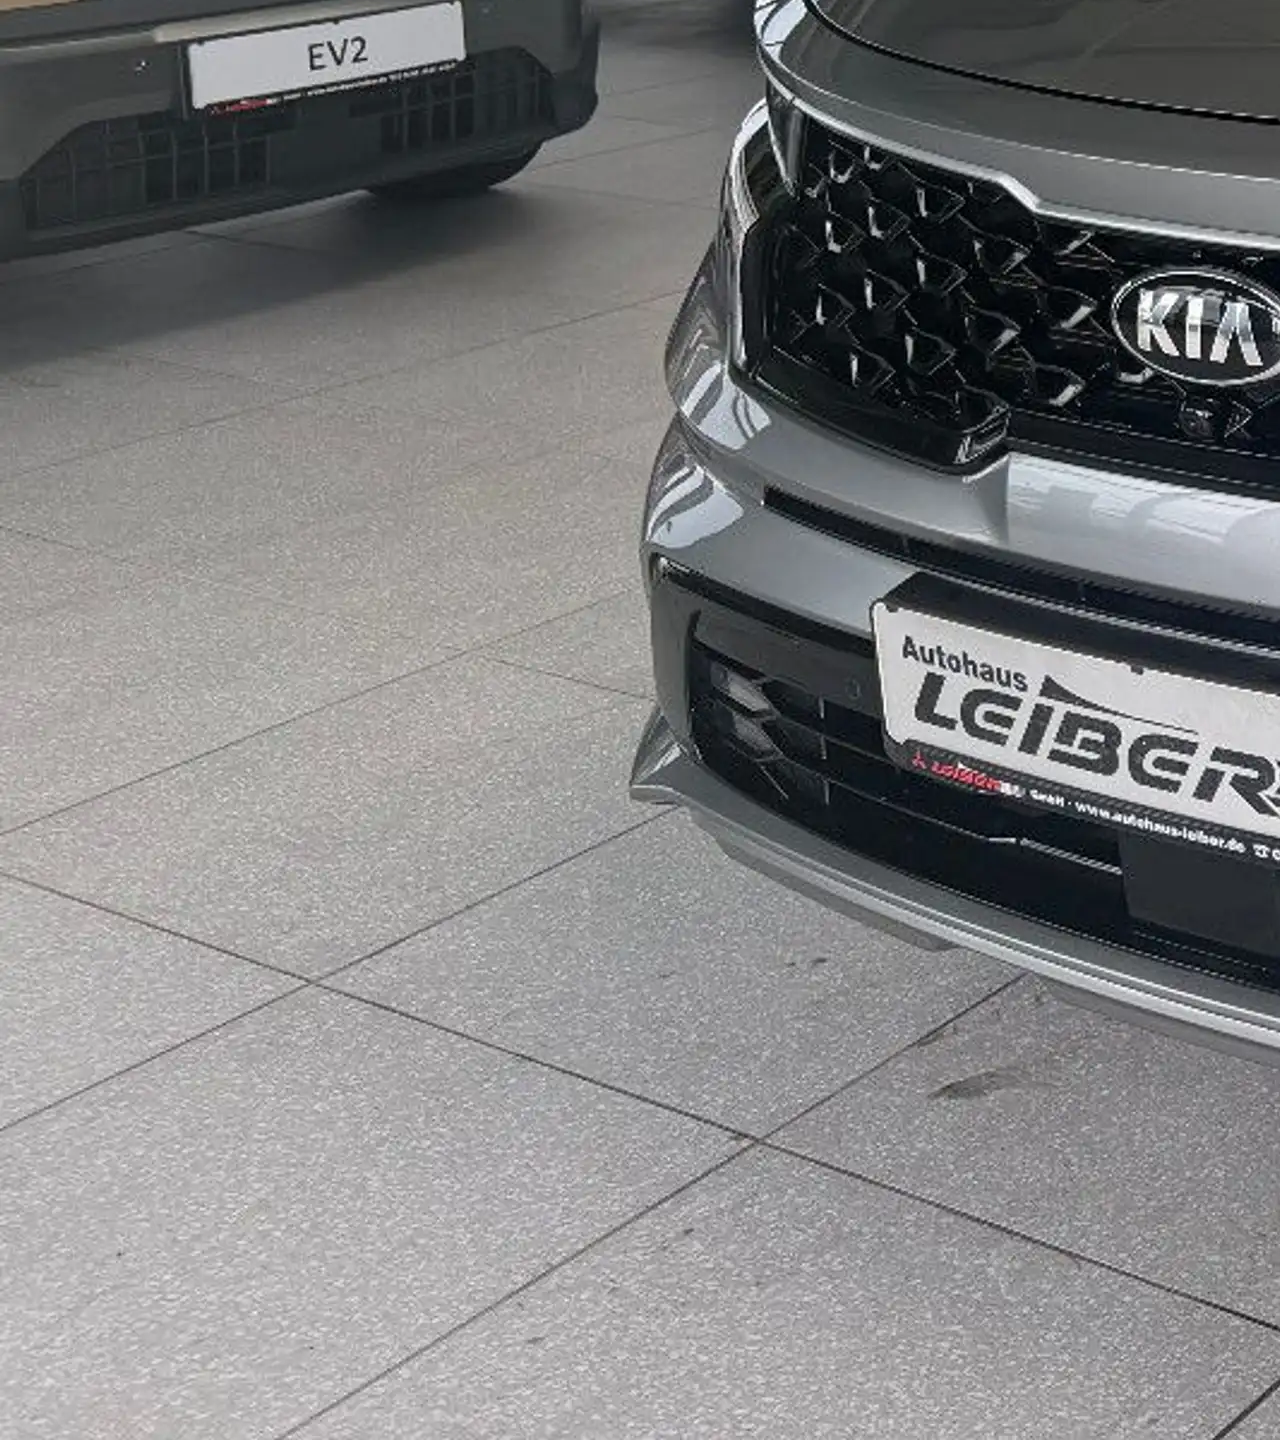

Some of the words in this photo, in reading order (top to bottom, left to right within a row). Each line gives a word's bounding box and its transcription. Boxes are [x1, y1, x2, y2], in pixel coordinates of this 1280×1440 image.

[307, 35, 369, 72] EV2
[1136, 287, 1264, 367] KIA
[902, 634, 1029, 693] Autohaus
